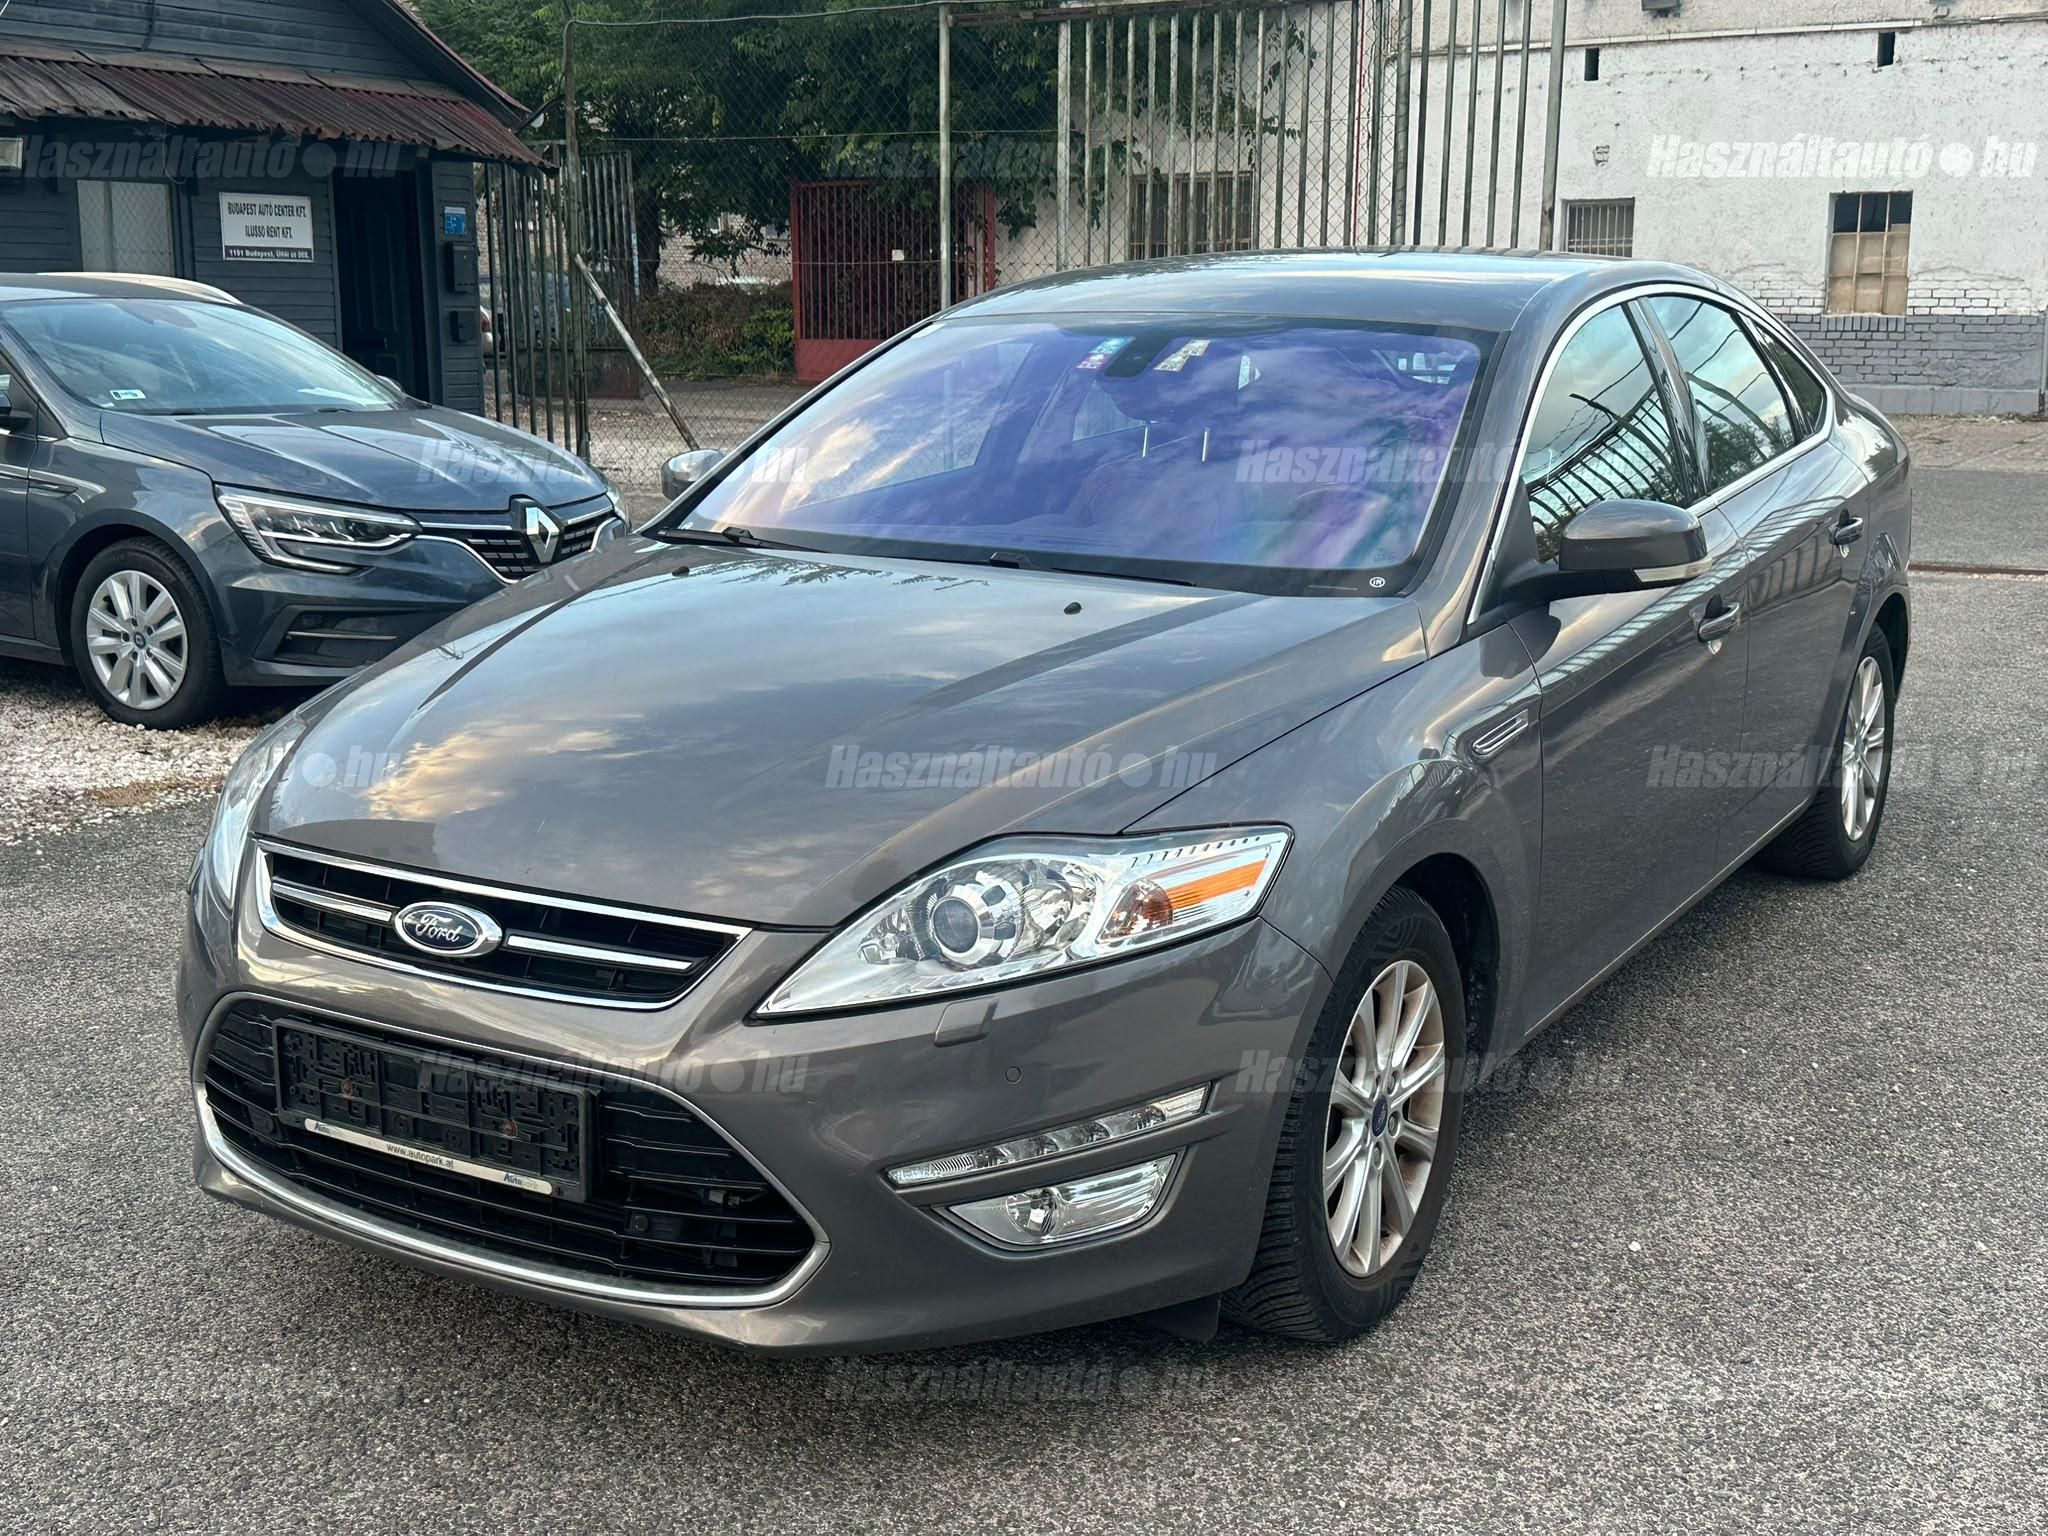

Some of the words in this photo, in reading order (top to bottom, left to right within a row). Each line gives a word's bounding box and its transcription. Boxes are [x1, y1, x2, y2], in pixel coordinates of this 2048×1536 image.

[227, 202, 256, 216] BUDAPEST
[274, 204, 295, 218] CENTER
[266, 226, 280, 239] RENT
[415, 913, 463, 942] Ford
